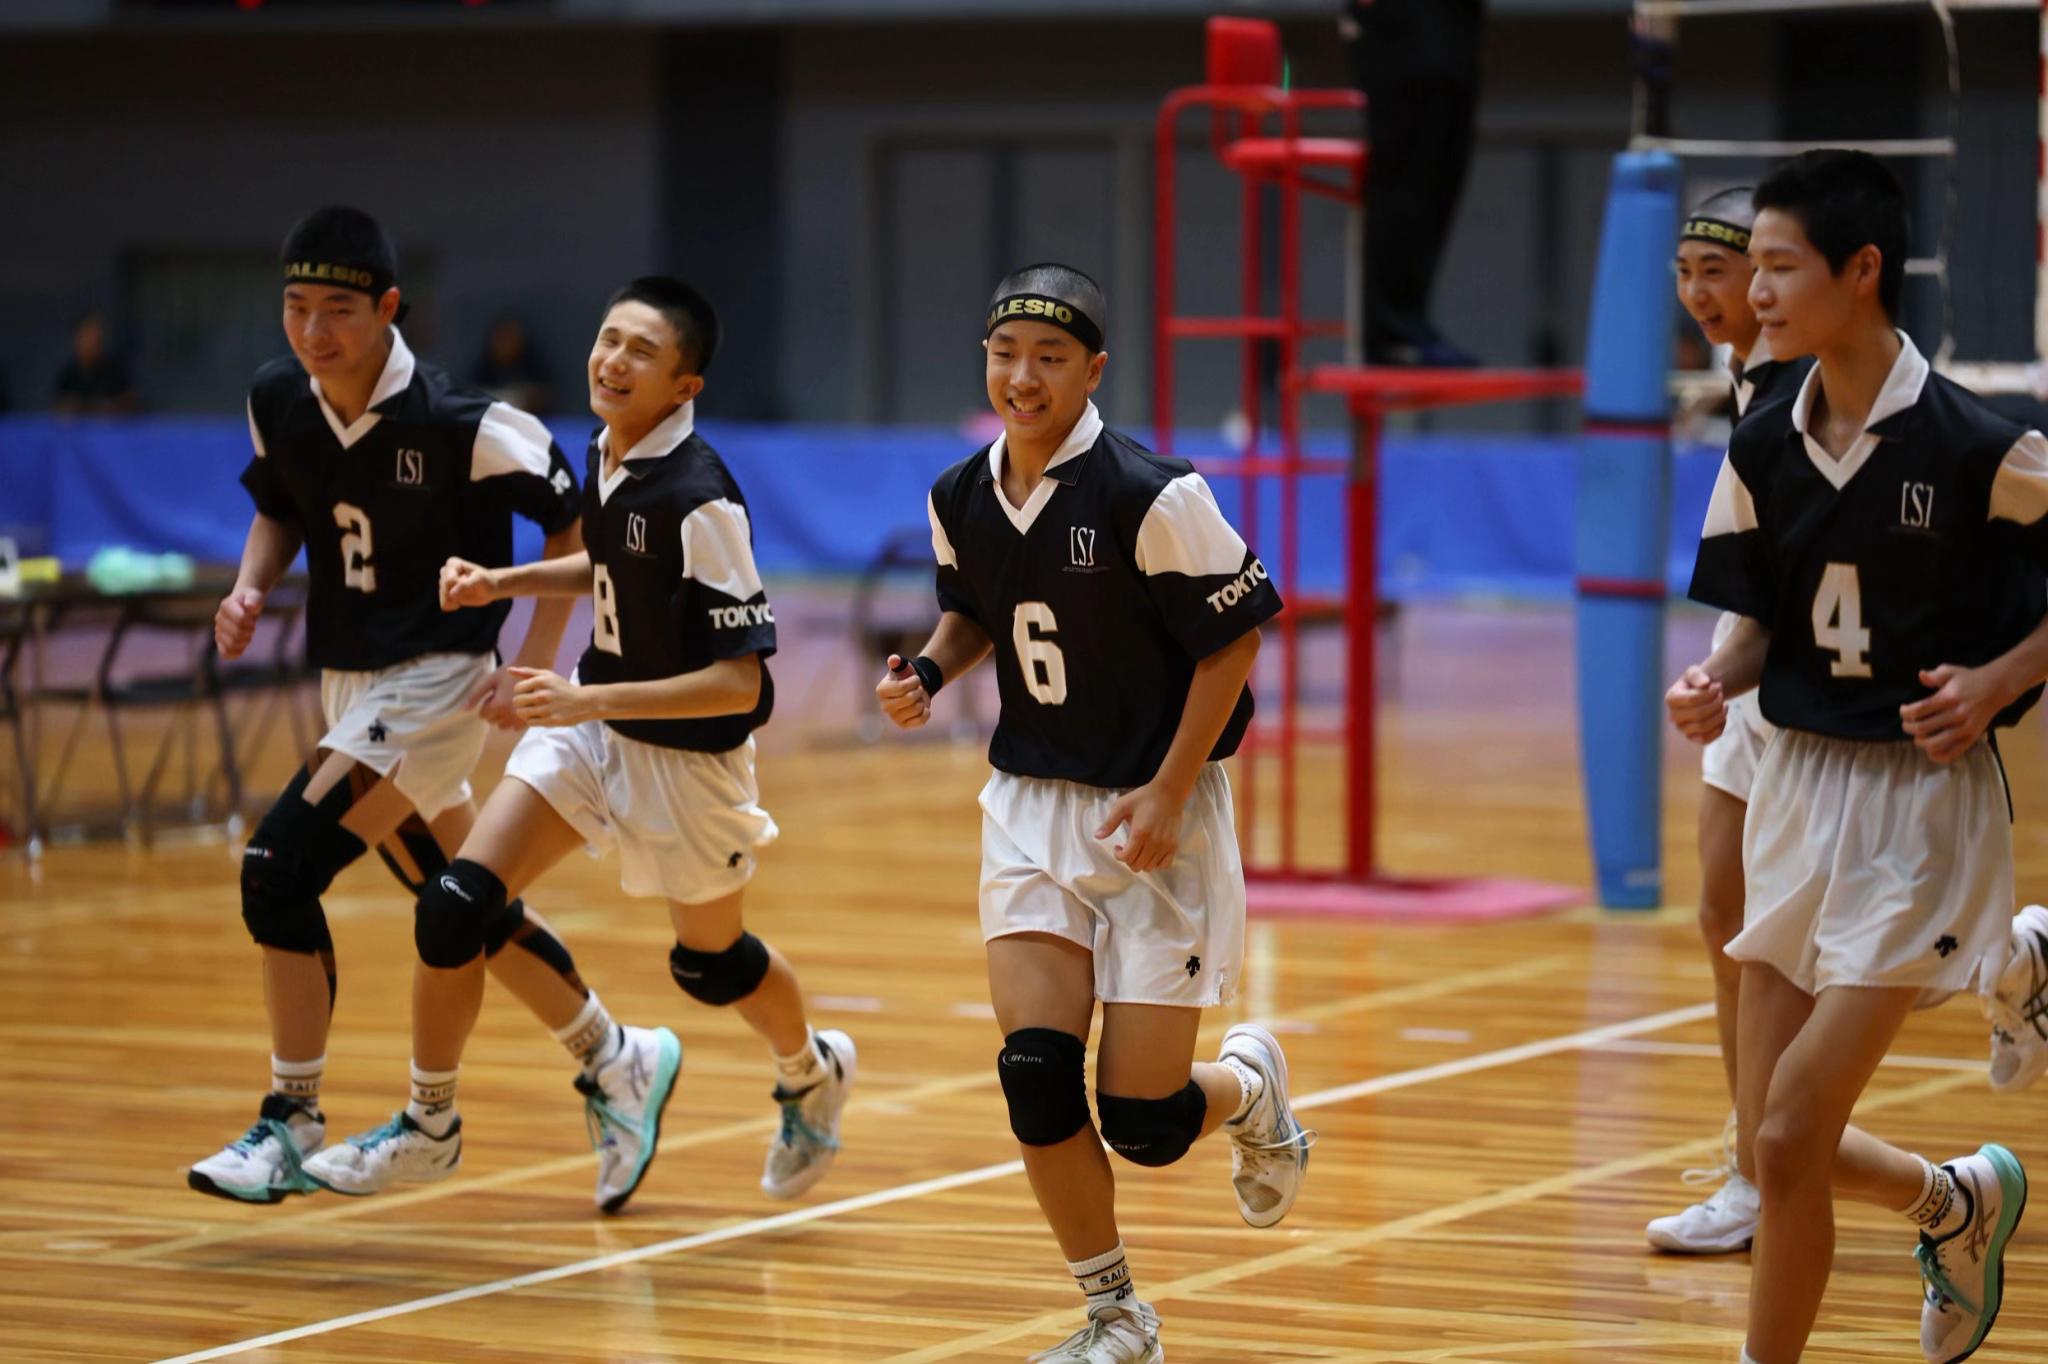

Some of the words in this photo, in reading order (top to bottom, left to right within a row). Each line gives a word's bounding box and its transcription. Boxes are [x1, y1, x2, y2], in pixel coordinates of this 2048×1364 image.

[1683, 221, 1750, 247] LESIO
[988, 299, 1073, 326] ALESIO
[333, 501, 376, 593] 2
[1206, 558, 1268, 614] TOKYO
[1812, 562, 1872, 677] 4
[1013, 601, 1067, 705] 6
